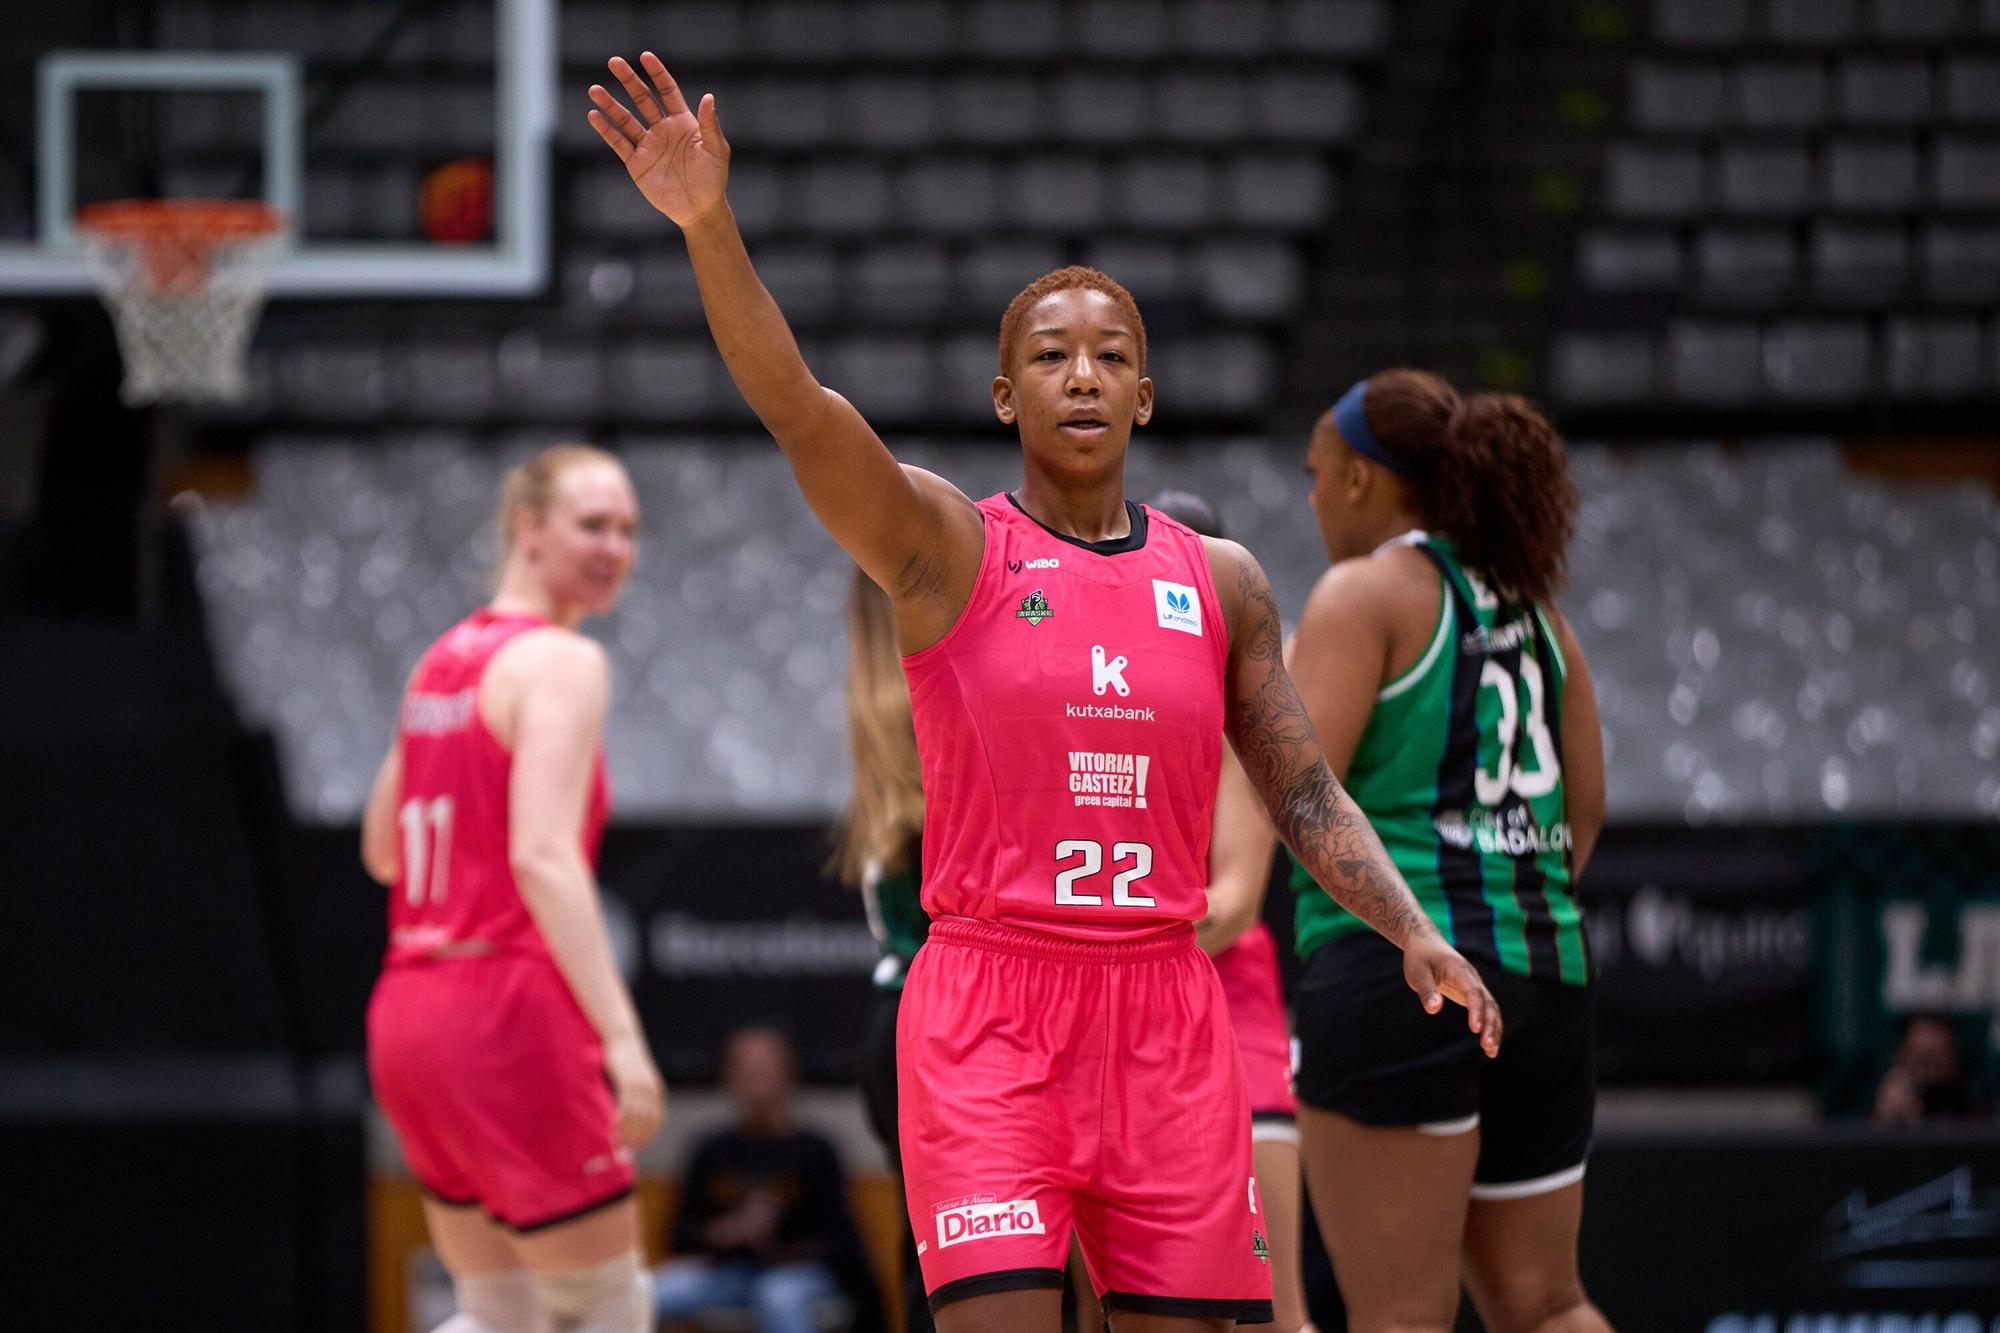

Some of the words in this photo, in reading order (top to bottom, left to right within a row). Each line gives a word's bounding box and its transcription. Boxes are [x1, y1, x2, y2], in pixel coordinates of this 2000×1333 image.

[1066, 702, 1156, 722] kutxabank
[1473, 652, 1562, 806] 33
[1068, 751, 1135, 774] VITORIA
[1068, 773, 1134, 795] GASTEIZ
[1074, 795, 1101, 808] green
[1102, 796, 1132, 809] capital
[400, 796, 455, 907] 11
[1055, 838, 1157, 908] 22
[943, 1204, 1035, 1242] Diario
